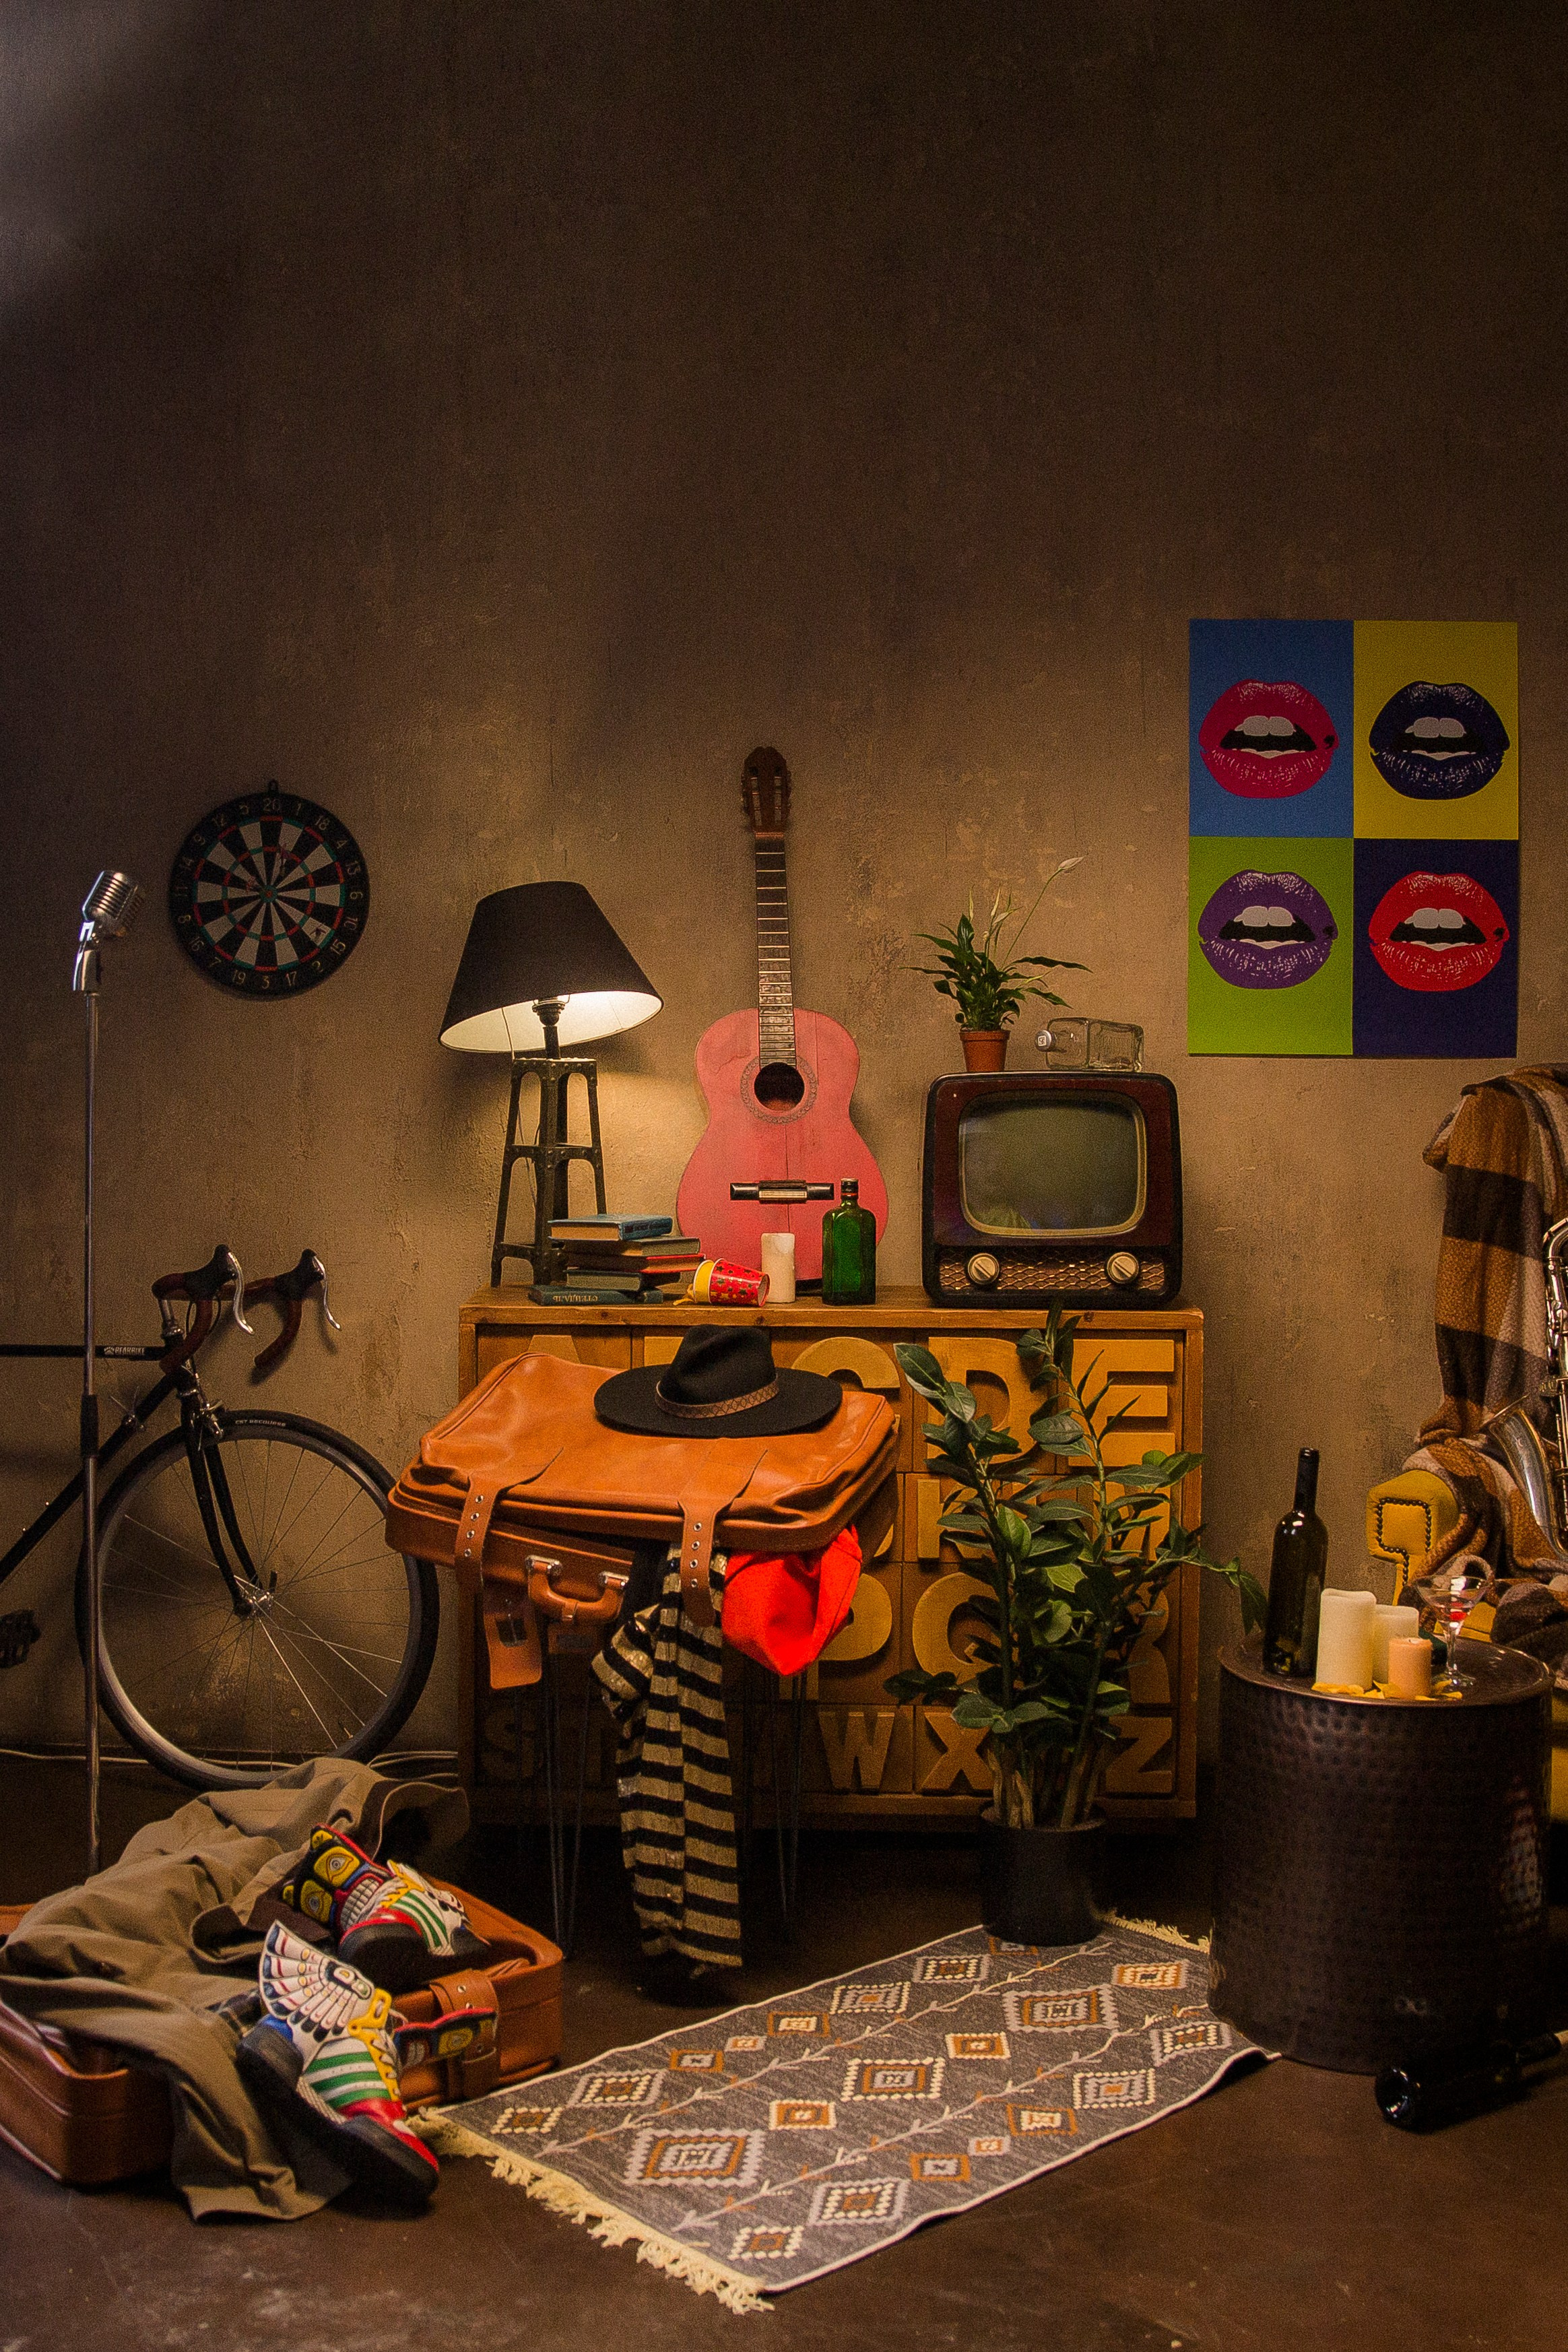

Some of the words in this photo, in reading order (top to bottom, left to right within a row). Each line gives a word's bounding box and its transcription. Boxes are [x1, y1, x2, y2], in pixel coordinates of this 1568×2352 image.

[263, 798, 281, 812] 20
[296, 803, 302, 816] 1
[212, 813, 226, 826] 12
[315, 815, 330, 830] 18
[193, 834, 206, 846] 9
[336, 839, 349, 850] 4
[178, 856, 194, 872] 14
[346, 860, 362, 875] 13
[350, 890, 364, 901] 6
[178, 913, 191, 924] 8
[189, 936, 205, 952] 16
[330, 938, 346, 956] 15
[208, 956, 222, 969] 7
[312, 960, 324, 973] 2
[232, 969, 247, 985] 19
[261, 975, 270, 989] 3
[285, 971, 298, 987] 17
[115, 1346, 145, 1355] BEARBIKE
